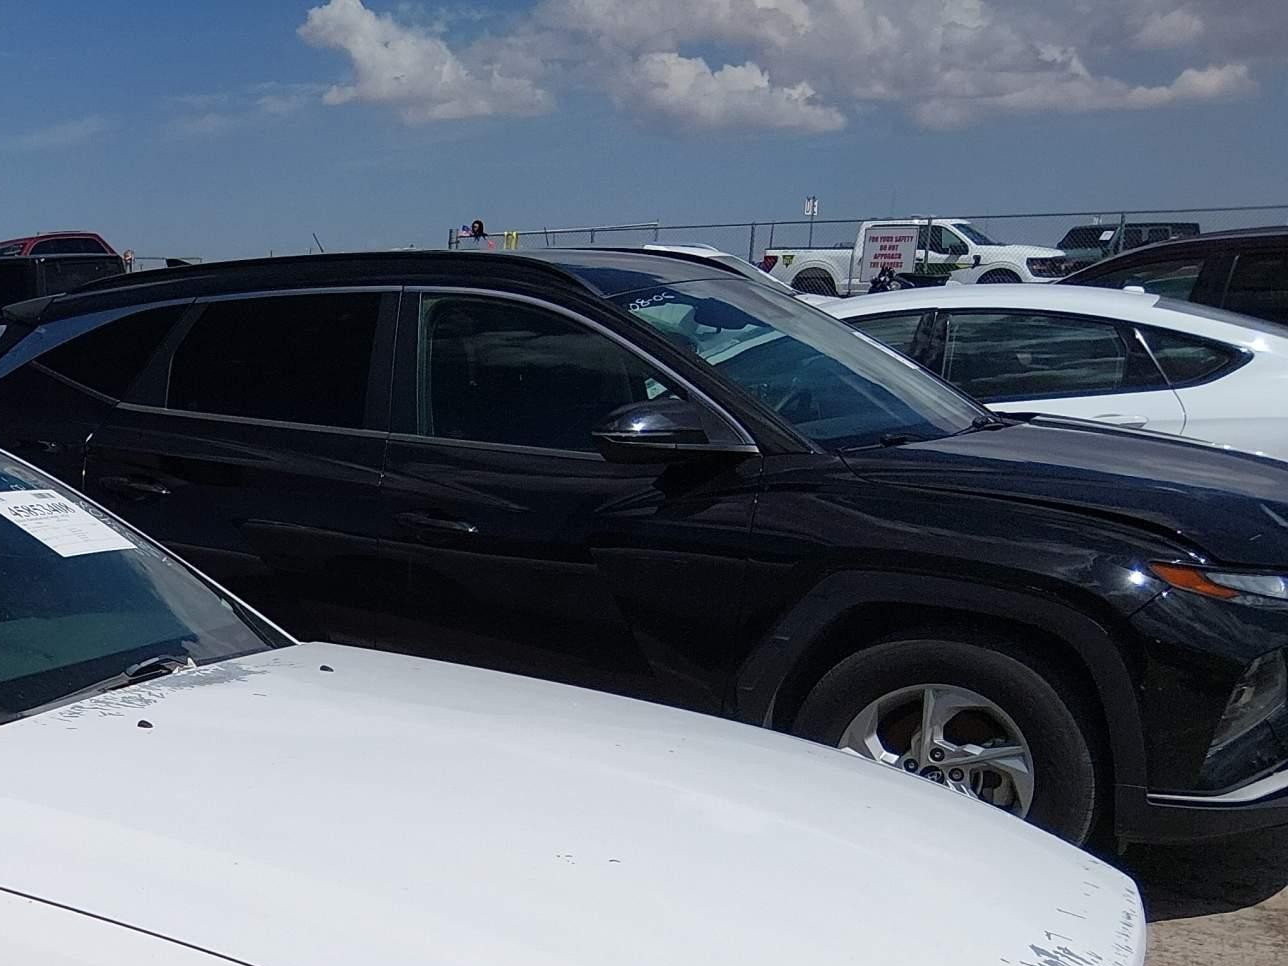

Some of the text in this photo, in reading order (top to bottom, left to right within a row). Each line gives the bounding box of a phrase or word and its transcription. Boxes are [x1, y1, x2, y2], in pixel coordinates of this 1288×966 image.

[868, 235, 914, 243] FOR YOUR SAFETY
